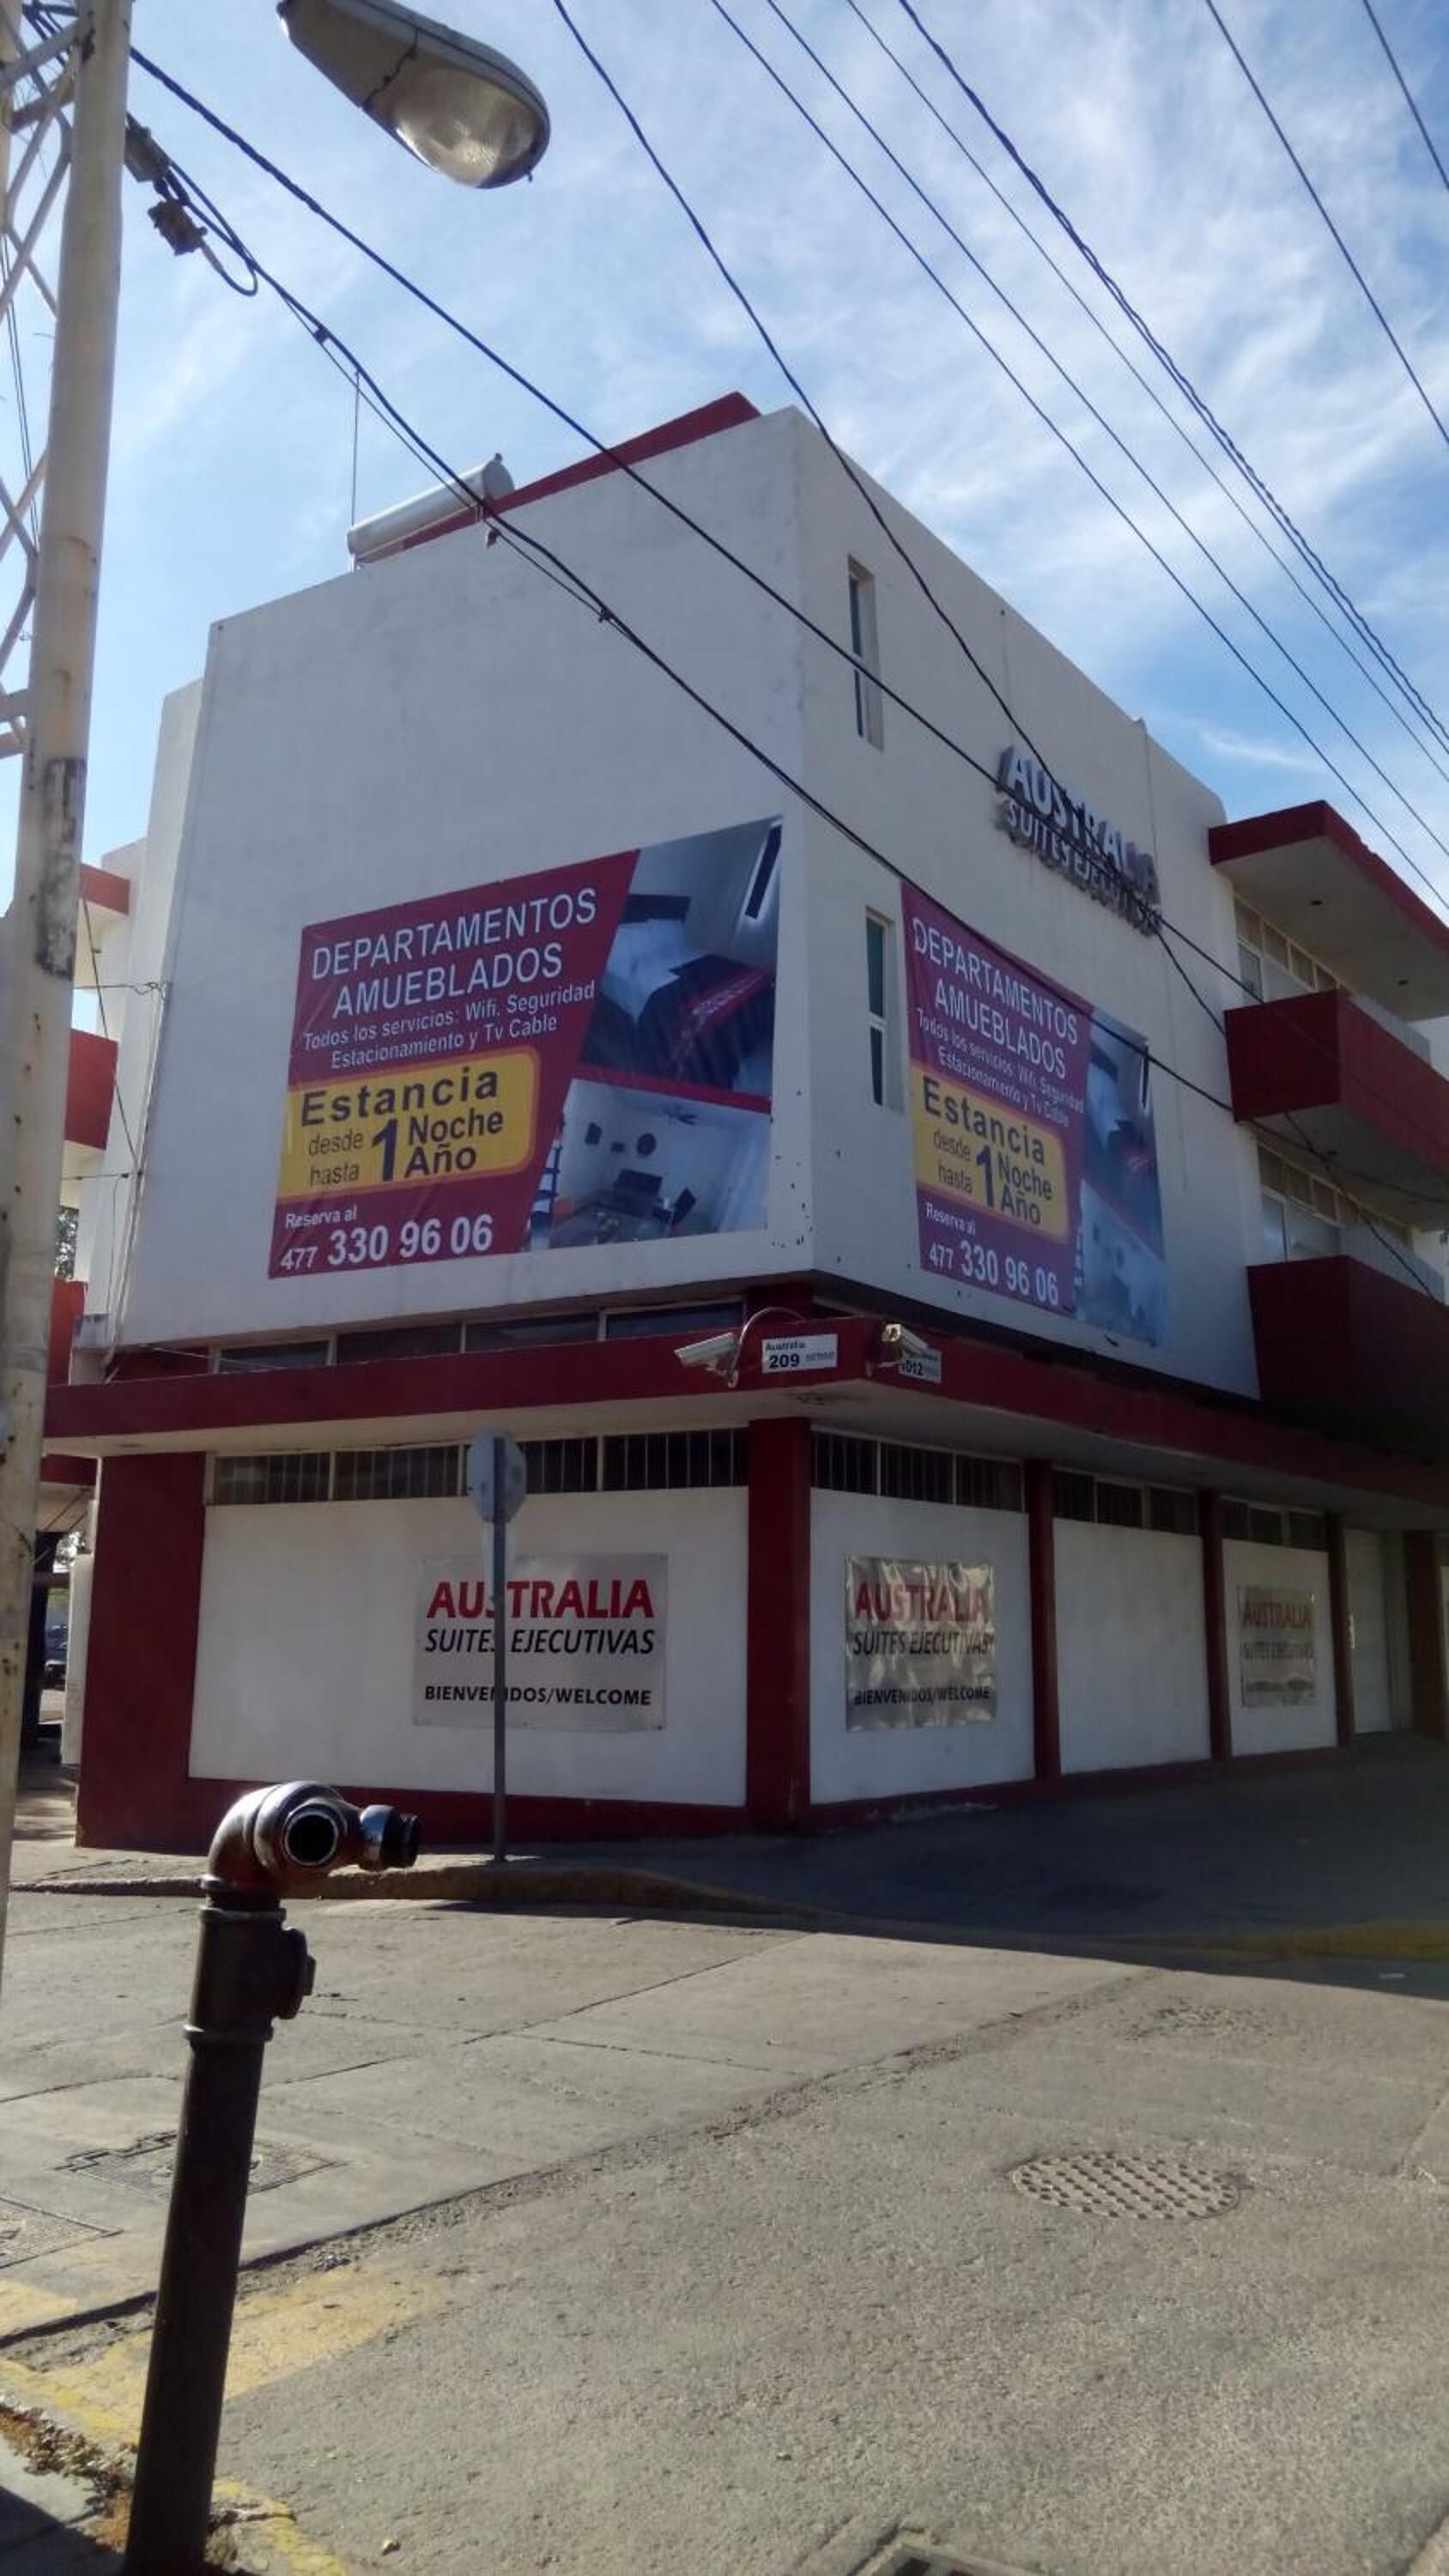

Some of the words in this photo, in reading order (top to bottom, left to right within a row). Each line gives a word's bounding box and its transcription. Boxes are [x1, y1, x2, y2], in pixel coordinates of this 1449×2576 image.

[312, 888, 597, 980] DEPARTAMENTOS
[333, 943, 562, 1019] AMUEBLADOS
[912, 918, 1077, 1045] DEPARTAMENTOS
[303, 1030, 349, 1051] Todos
[355, 1024, 377, 1042] los
[507, 980, 595, 1016] Seguridad
[331, 1030, 464, 1069] Estacionamiento
[470, 1033, 477, 1050] y
[485, 1023, 503, 1042] Tv
[510, 1013, 556, 1038] Cable
[935, 978, 1065, 1079] AMUEBLADOS
[301, 1066, 498, 1127] Estancia
[923, 1076, 1044, 1165] Estancia
[309, 1130, 363, 1157] desde
[371, 1119, 398, 1182] 1
[408, 1107, 503, 1145] Noche
[310, 1162, 359, 1186] hasta
[404, 1143, 476, 1178] Año
[934, 1127, 971, 1161] desde
[976, 1145, 994, 1208] 1
[998, 1152, 1052, 1200] Noche
[286, 1209, 340, 1229] Reserva
[343, 1206, 357, 1223] al
[926, 1202, 965, 1232] Reserva
[938, 1160, 972, 1194] hasta
[1000, 1184, 1041, 1225] Año
[281, 1247, 318, 1270] 477
[328, 1225, 389, 1266] 330
[400, 1218, 441, 1258] 96
[451, 1213, 493, 1255] 06
[930, 1242, 954, 1270] 477
[961, 1241, 998, 1286] 330
[1004, 1256, 1030, 1296] 96
[1035, 1268, 1059, 1306] 06
[769, 1352, 800, 1370] 209
[425, 1629, 495, 1653] SUITE
[511, 1629, 656, 1654] EJECUTIVAS
[853, 1631, 906, 1656] SUITES
